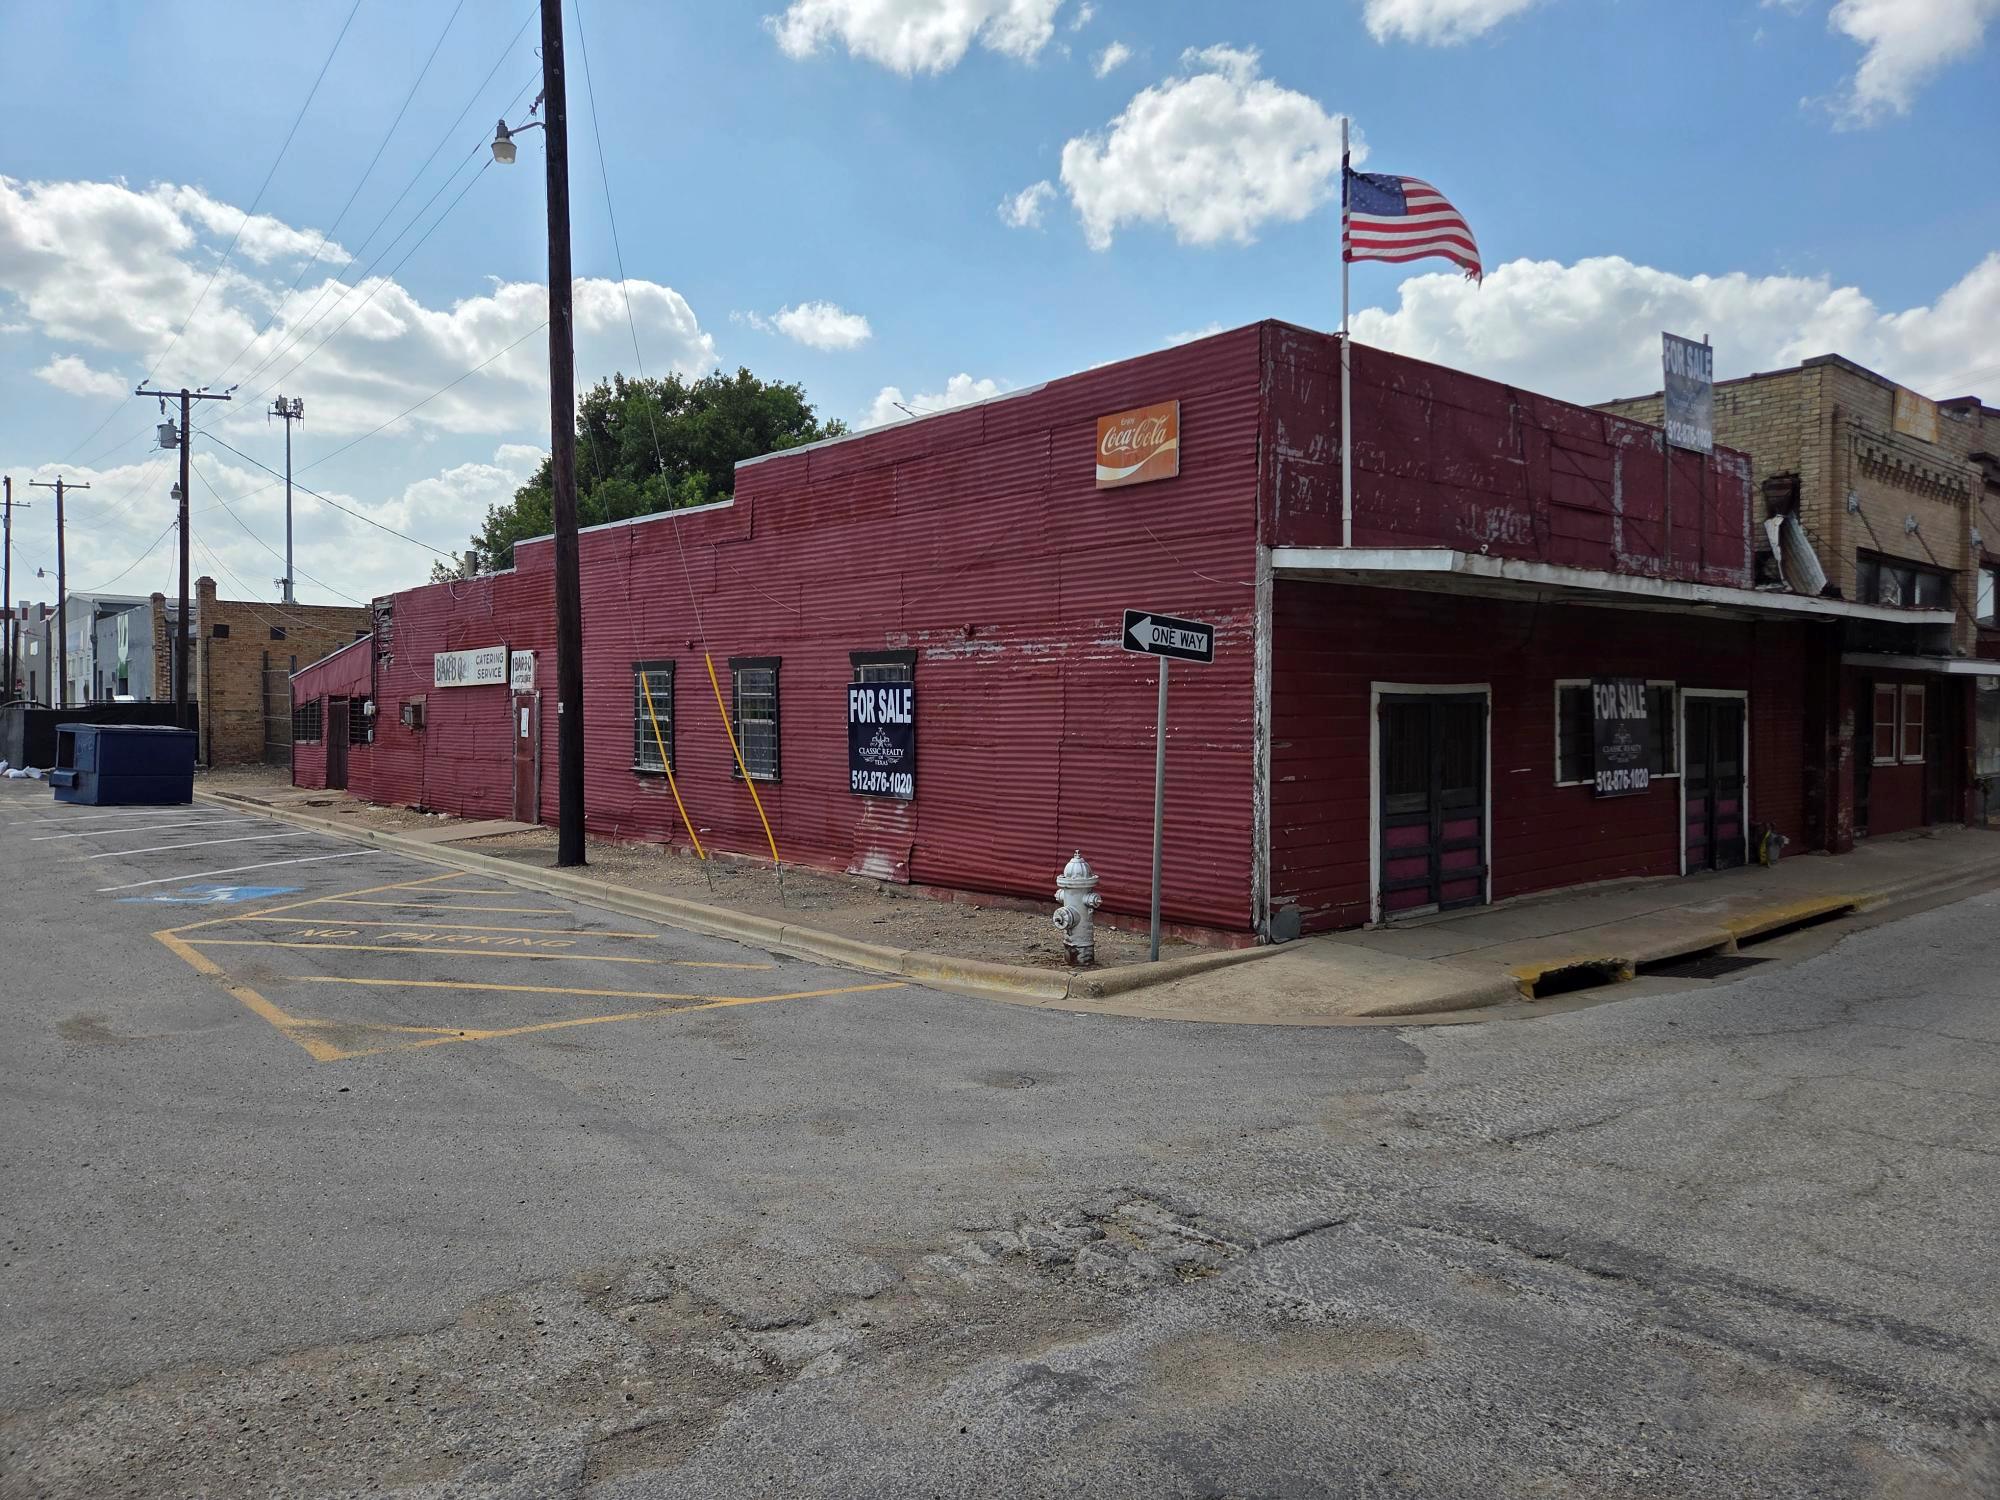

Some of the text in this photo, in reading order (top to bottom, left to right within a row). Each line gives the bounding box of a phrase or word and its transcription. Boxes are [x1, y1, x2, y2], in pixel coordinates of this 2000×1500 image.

[1663, 338, 1711, 385] FOR SALE
[1101, 414, 1169, 456] Coca-Cola
[1152, 627, 1204, 650] ONE WAY
[475, 652, 504, 666] CATERING
[477, 666, 502, 679] SERVICE
[849, 688, 912, 724] FOR SALE
[1592, 683, 1648, 720] FOR SALE
[858, 746, 905, 756] CLASSIC REALTY
[852, 769, 913, 794] 512-876-1020
[1596, 768, 1649, 792] 512-876-1020
[289, 928, 577, 948] NO PARKING
